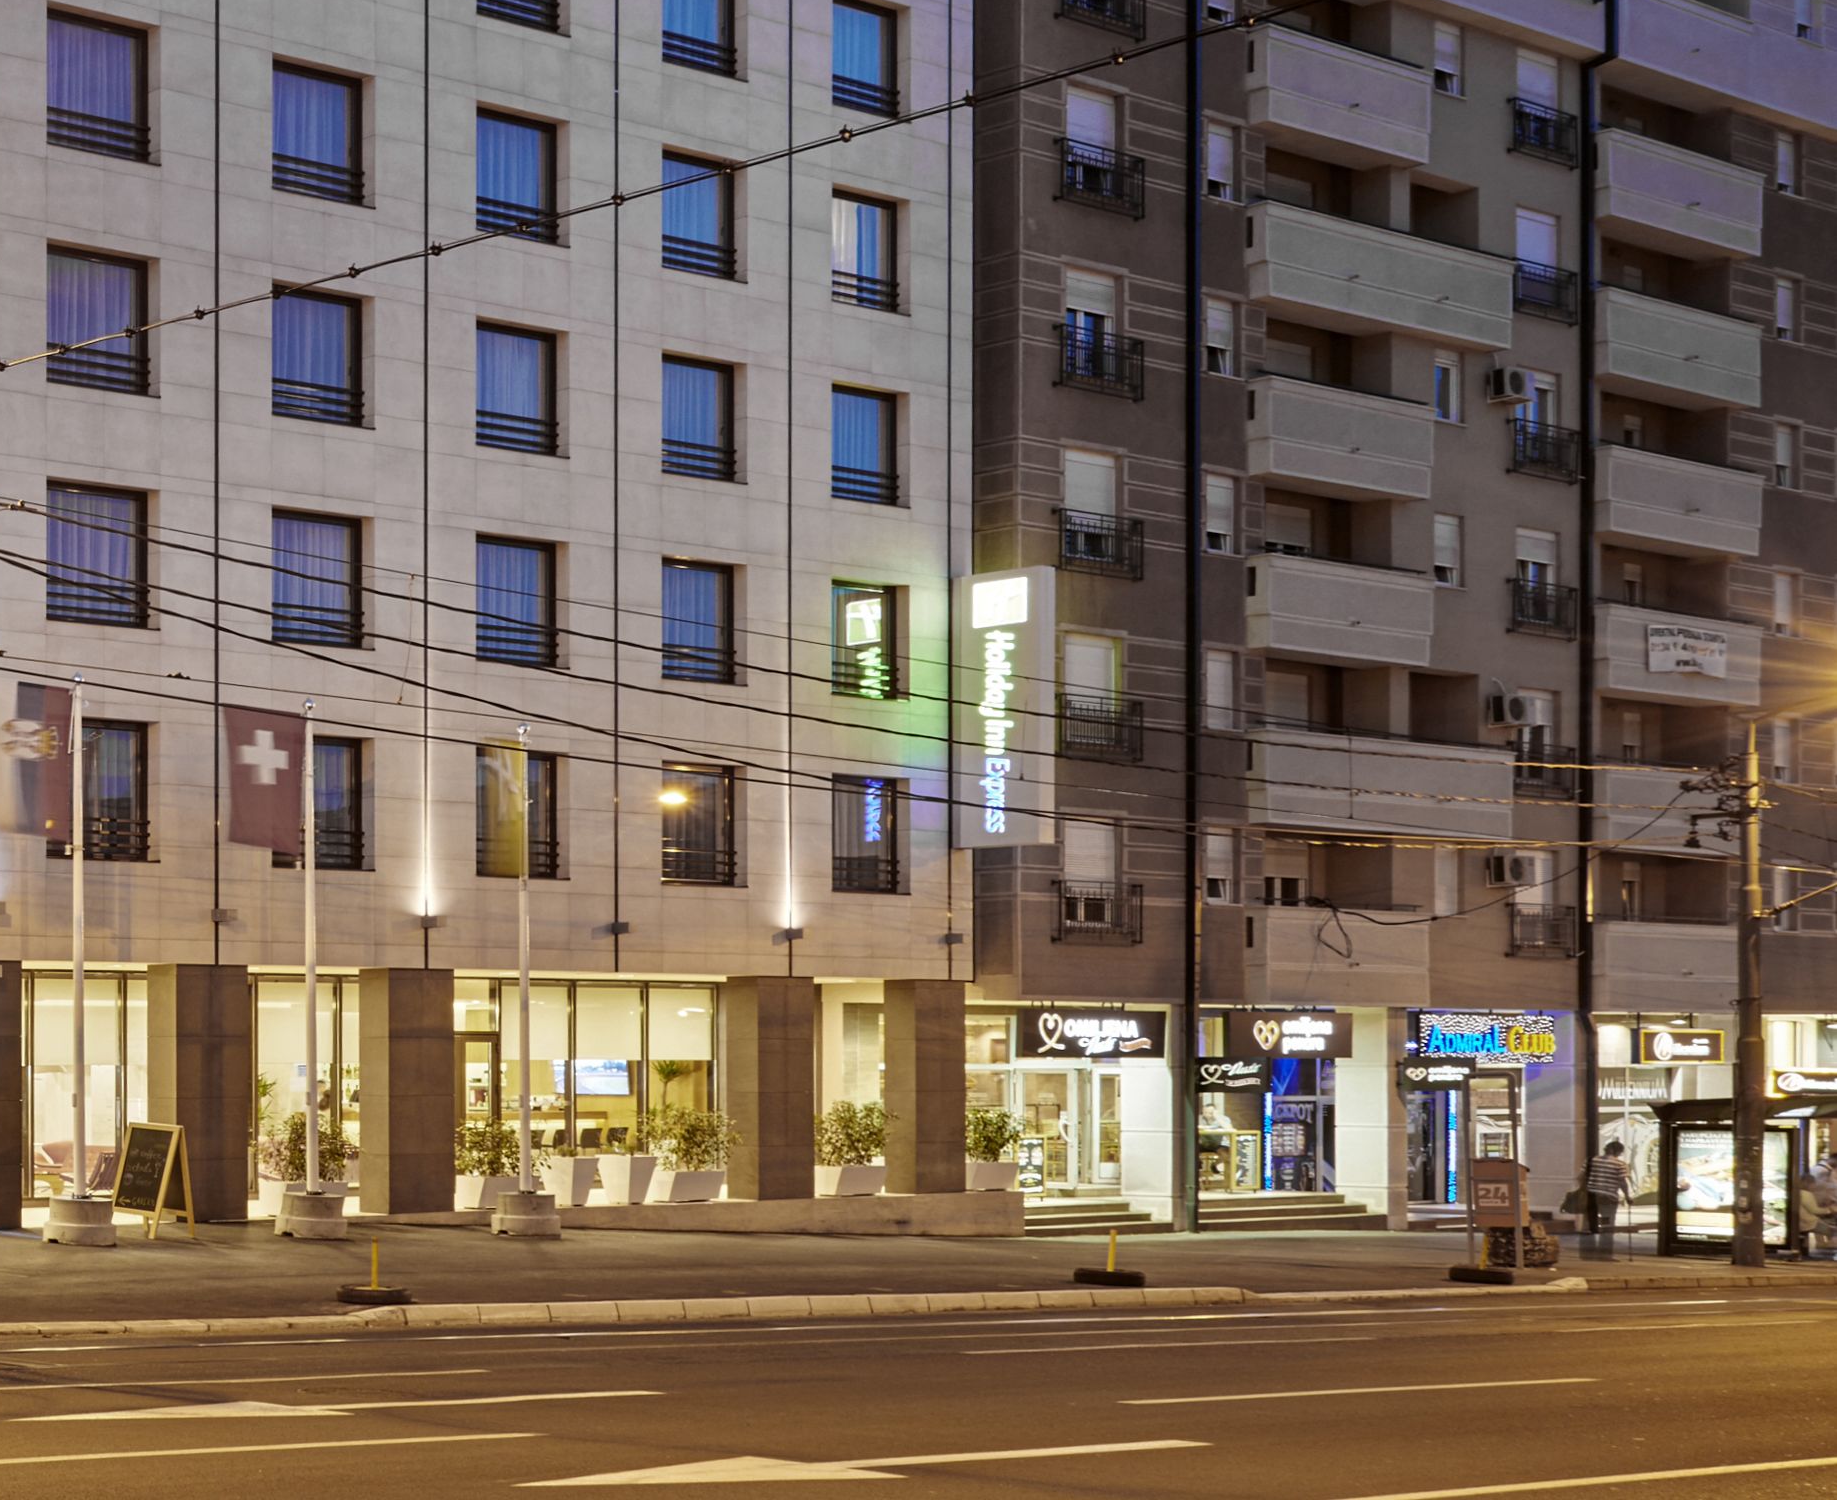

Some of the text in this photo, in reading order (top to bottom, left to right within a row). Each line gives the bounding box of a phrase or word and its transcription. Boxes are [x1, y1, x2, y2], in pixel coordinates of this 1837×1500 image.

[978, 631, 1015, 834] Holiday Inn Express
[1478, 1186, 1509, 1204] 24
